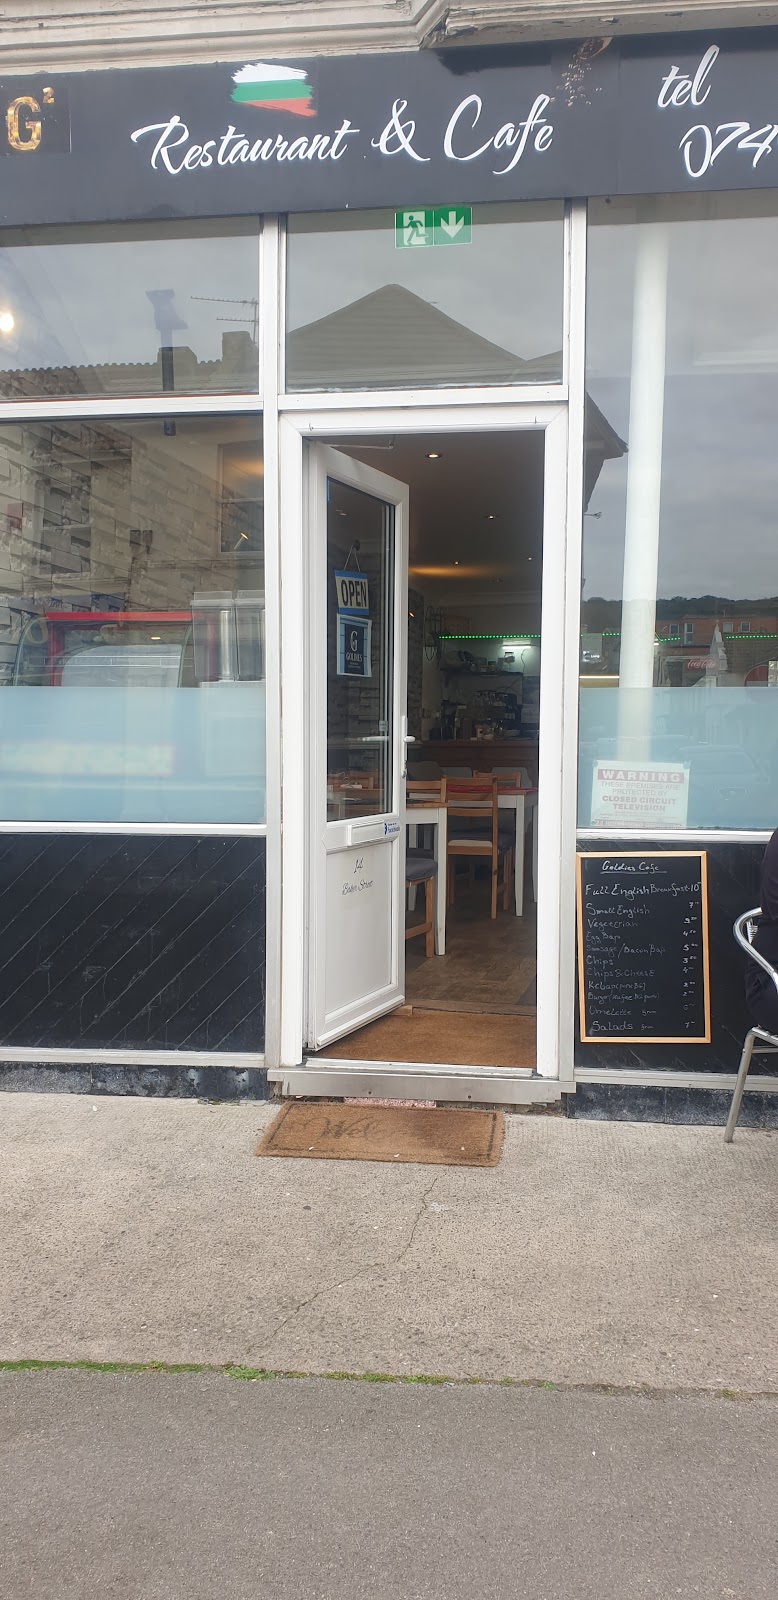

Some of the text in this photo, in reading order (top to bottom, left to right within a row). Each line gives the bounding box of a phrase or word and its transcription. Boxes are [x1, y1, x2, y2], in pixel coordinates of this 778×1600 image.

[657, 44, 720, 108] tel
[130, 93, 554, 175] Restaurant & Cafe
[340, 579, 367, 607] OPEN
[602, 770, 681, 782] WARNING
[612, 788, 656, 796] PROTECTED
[602, 795, 677, 805] CLOSED CIRCUIT
[613, 803, 666, 812] TELEVISION
[602, 860, 659, 874] Goldies Cafe
[585, 883, 608, 896] Full
[611, 883, 650, 901] English
[586, 902, 615, 916] Small
[617, 904, 650, 918] English
[585, 931, 602, 945] Egg
[601, 931, 621, 944] Bap
[586, 955, 614, 970] Chips
[586, 968, 614, 981] Chips
[592, 1020, 634, 1032] Salads
